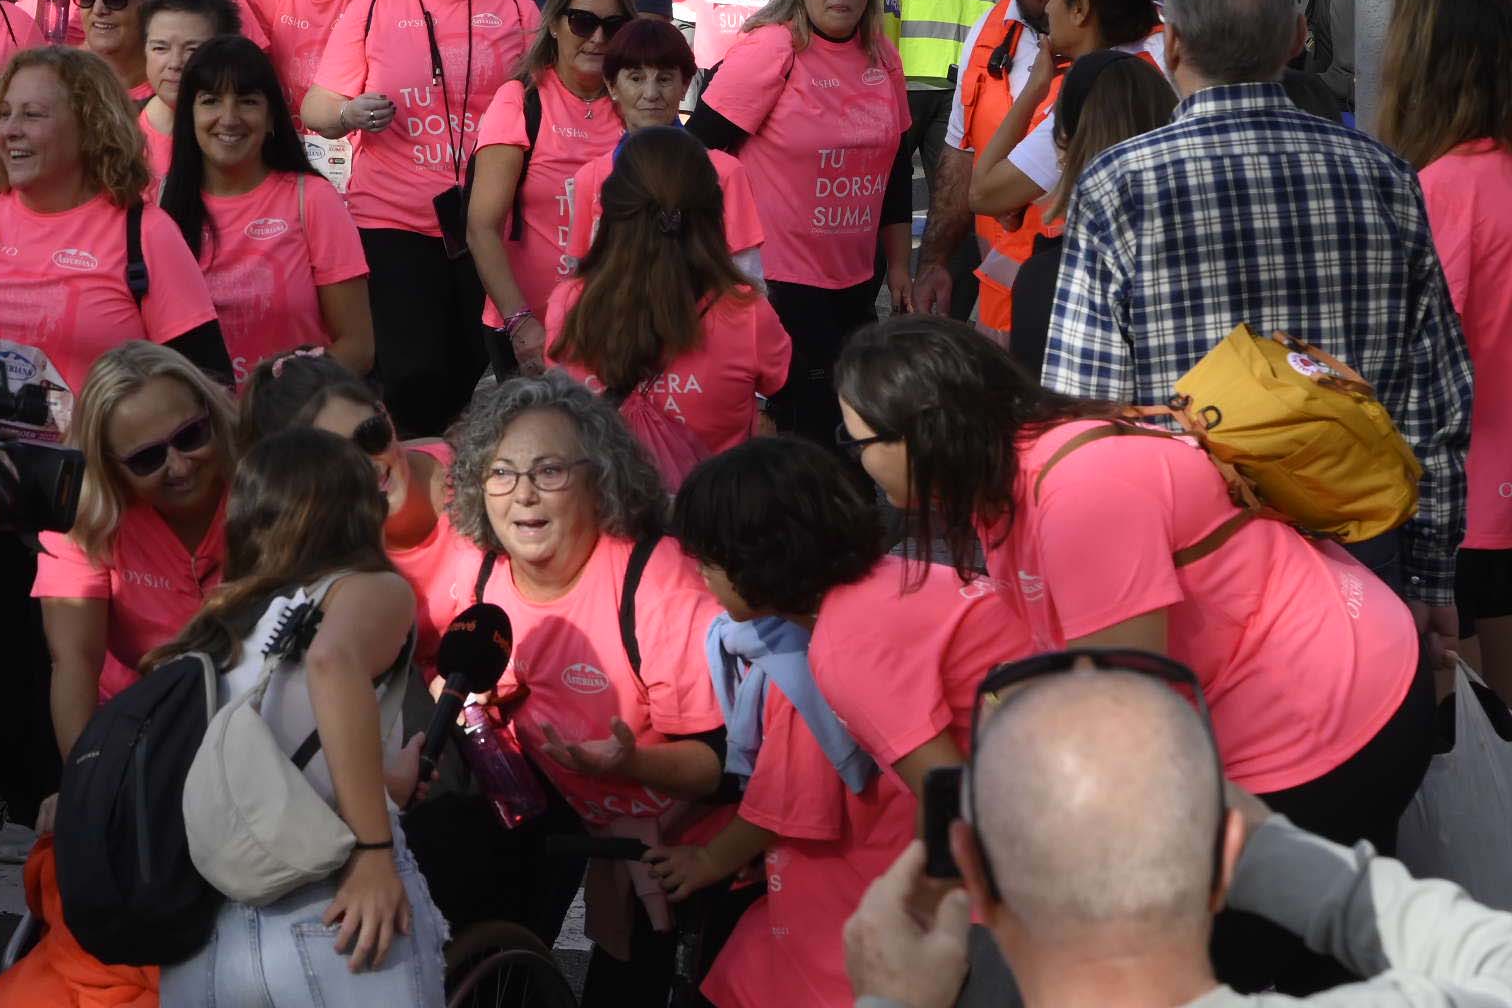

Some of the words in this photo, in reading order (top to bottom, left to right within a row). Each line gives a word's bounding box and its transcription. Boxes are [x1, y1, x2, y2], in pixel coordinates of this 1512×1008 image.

[400, 87, 431, 109] TU
[818, 149, 845, 169] TU
[815, 174, 889, 198] DORSAL
[811, 205, 872, 228] SUMA
[54, 247, 97, 269] ASTURIANA
[565, 674, 607, 689] ASTURIANA
